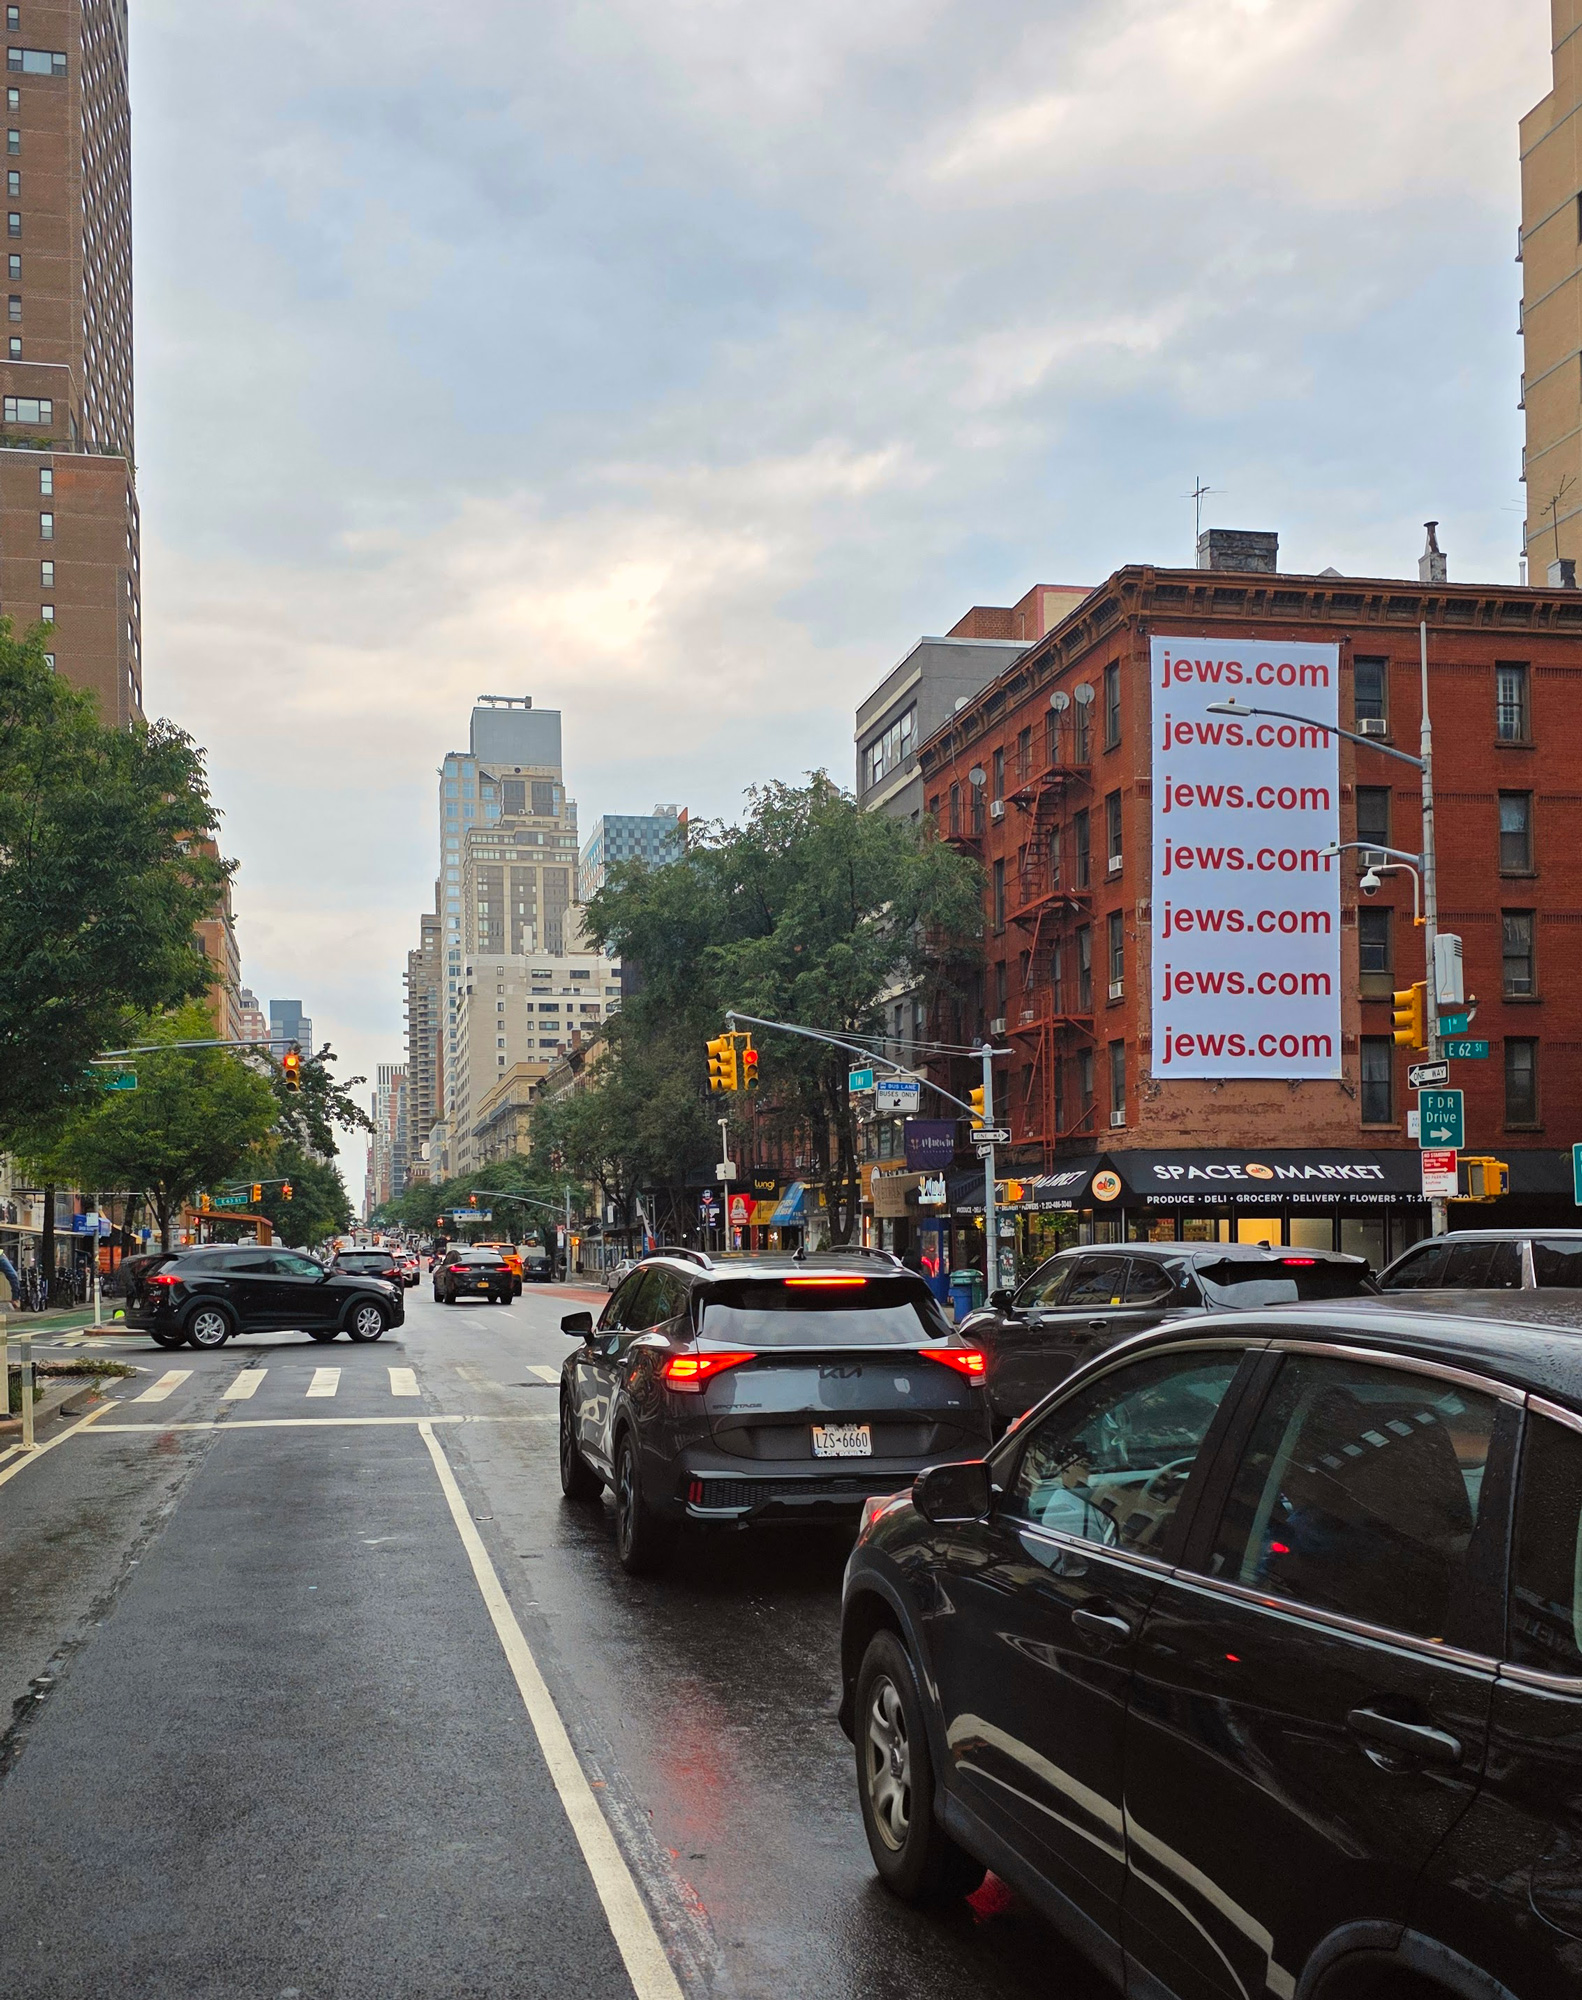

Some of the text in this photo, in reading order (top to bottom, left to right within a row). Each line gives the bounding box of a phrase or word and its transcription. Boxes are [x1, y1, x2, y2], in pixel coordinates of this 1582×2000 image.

[1162, 651, 1329, 688] jews.com
[1162, 714, 1329, 750] jews.com
[1162, 776, 1330, 813] jews.com
[1162, 839, 1331, 875] jews.com
[1162, 901, 1331, 938] jews.com
[1163, 964, 1331, 1001] jews.com
[1163, 1026, 1332, 1064] jews.com
[1449, 1043, 1482, 1057] E 62 St
[1413, 1068, 1444, 1081] ONE WAY
[1428, 1096, 1454, 1109] FDR
[1426, 1111, 1457, 1124] Drive
[1153, 1165, 1385, 1180] SPACE MARKET
[1146, 1195, 1195, 1204] PRODUCE
[1204, 1195, 1227, 1204] DELI
[1236, 1194, 1284, 1203] GROCERY
[1292, 1194, 1341, 1203] DELIVERY
[1350, 1194, 1397, 1203] FLOWERS
[819, 1367, 862, 1379] KIA
[842, 1432, 868, 1448] 6660
